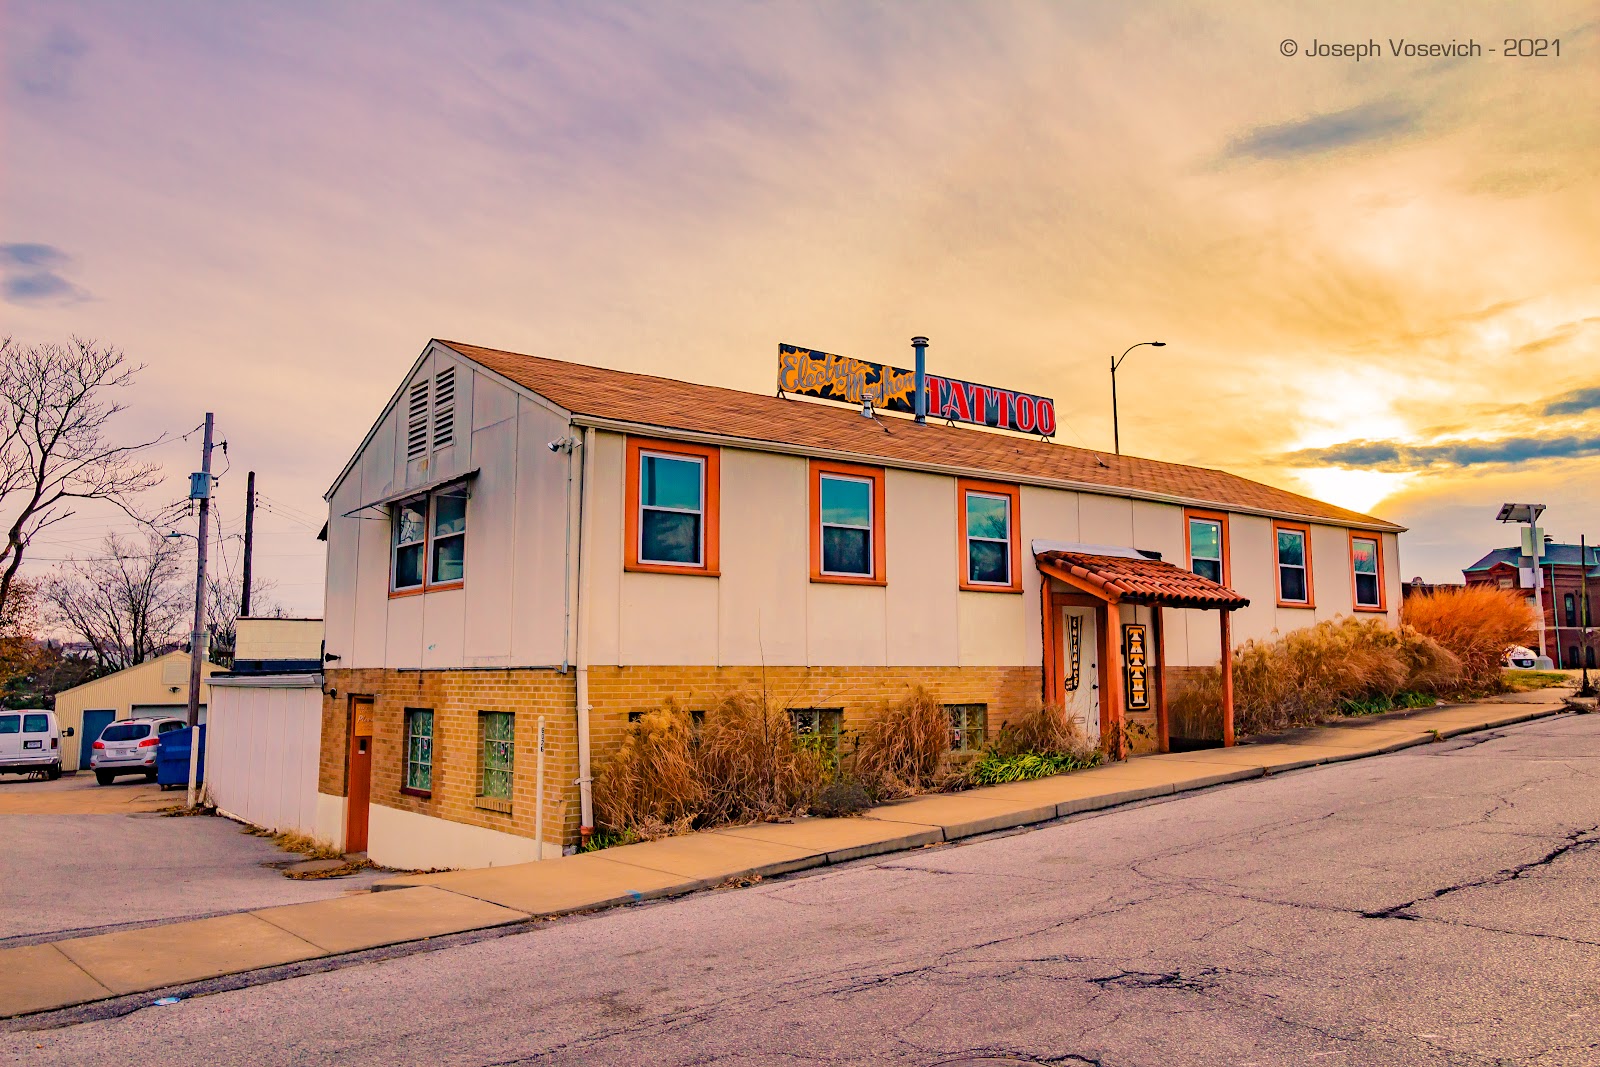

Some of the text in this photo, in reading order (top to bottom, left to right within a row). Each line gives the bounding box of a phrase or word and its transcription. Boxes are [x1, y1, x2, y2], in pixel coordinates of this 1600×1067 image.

[780, 354, 866, 390] Electric
[925, 375, 1055, 436] TATTOO
[1129, 629, 1145, 703] TATTOO
